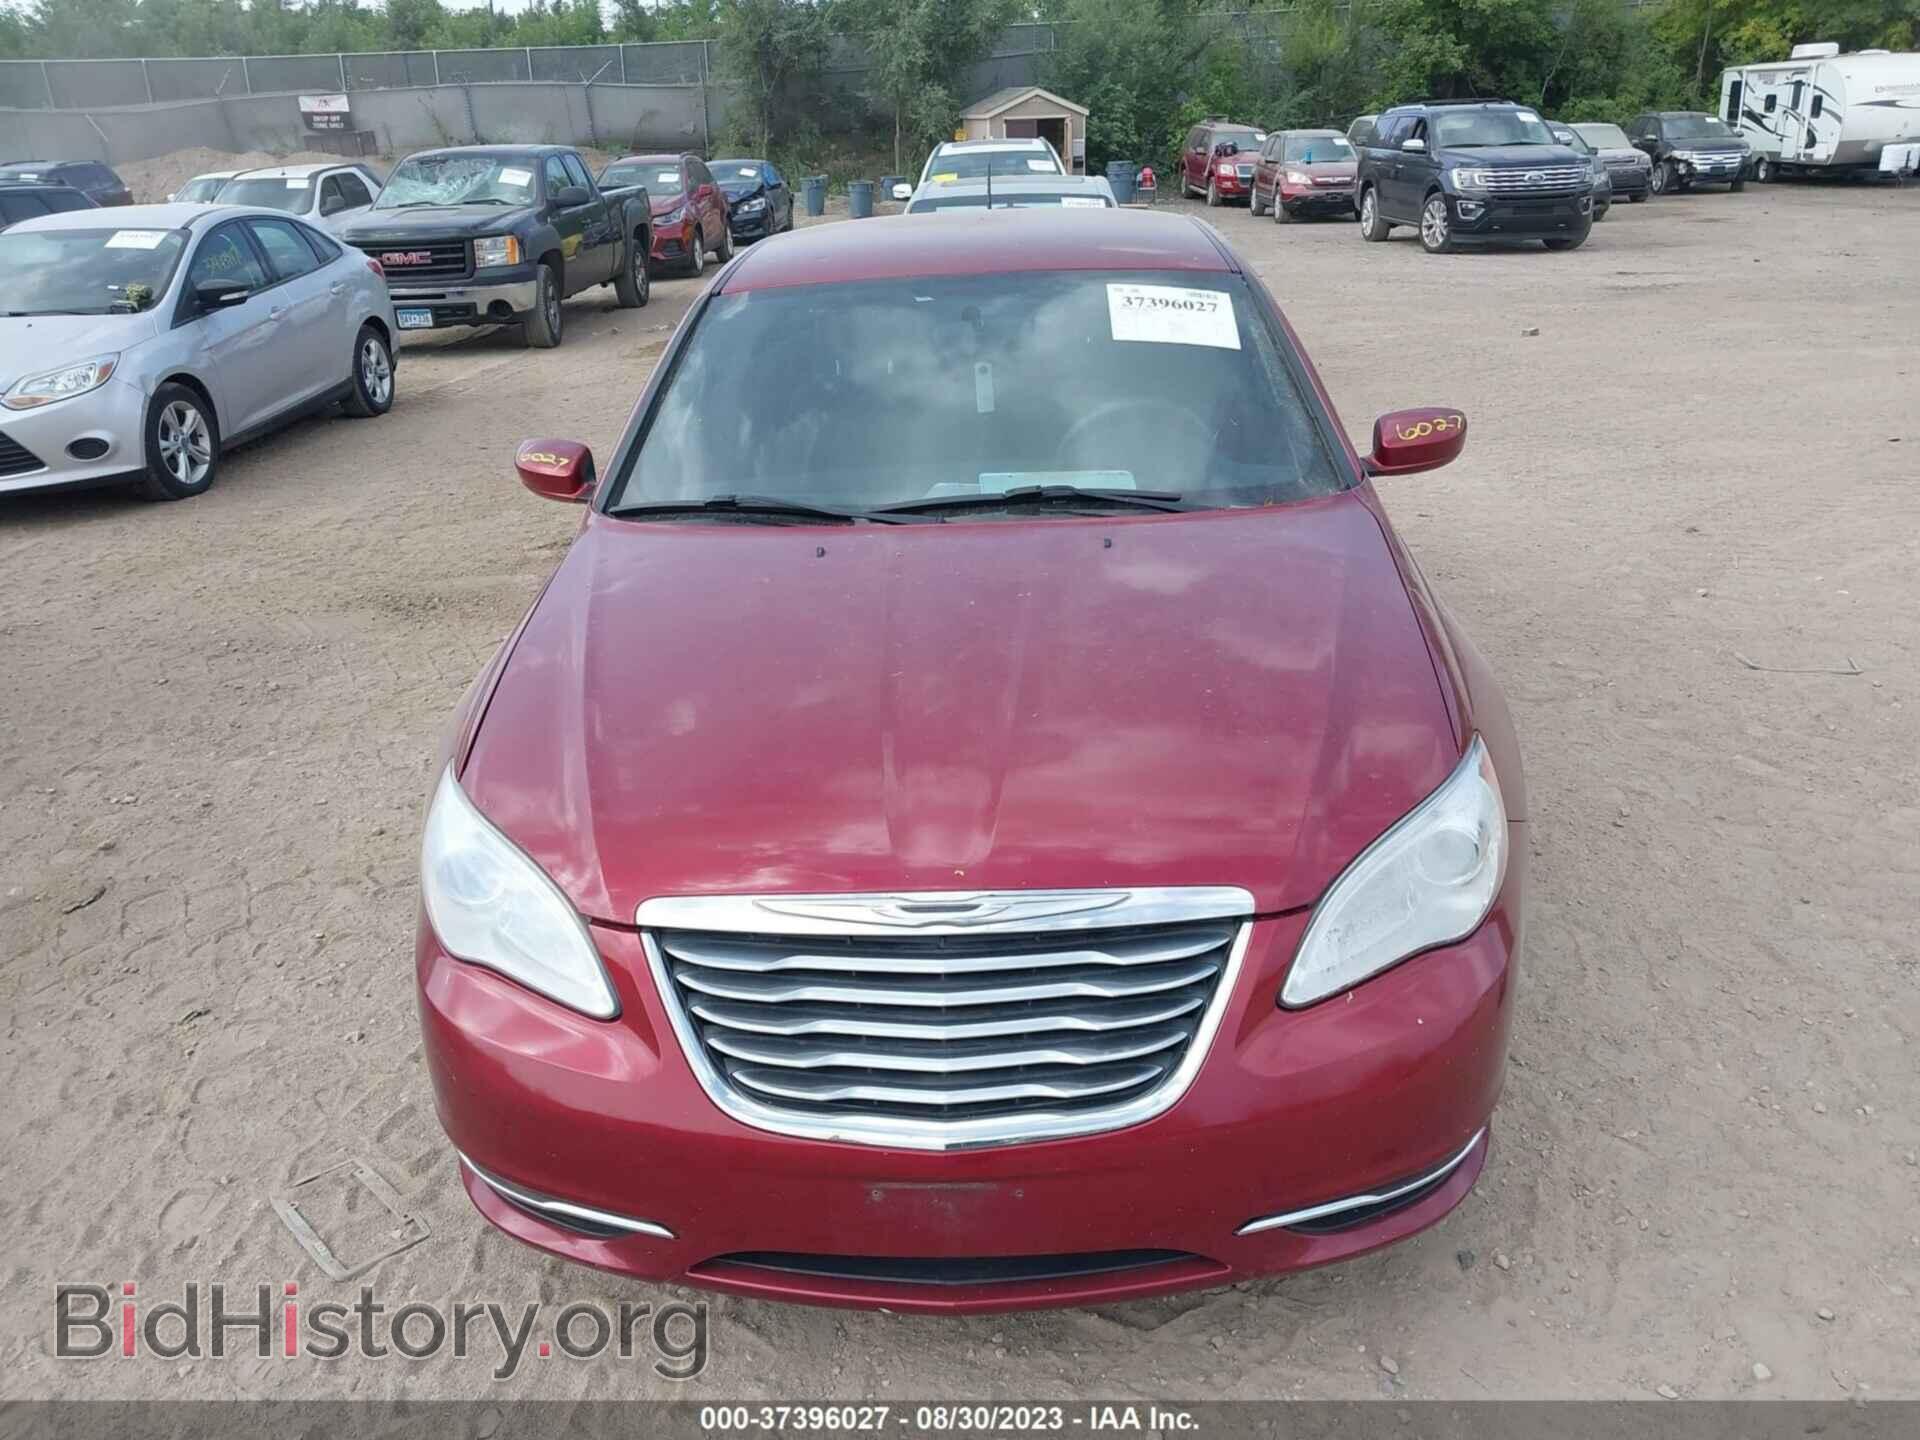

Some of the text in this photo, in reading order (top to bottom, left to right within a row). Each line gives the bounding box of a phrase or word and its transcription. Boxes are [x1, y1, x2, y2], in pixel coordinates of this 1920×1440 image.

[382, 251, 432, 266] GMC
[1122, 296, 1218, 313] 37396027
[1395, 415, 1462, 441] 6027
